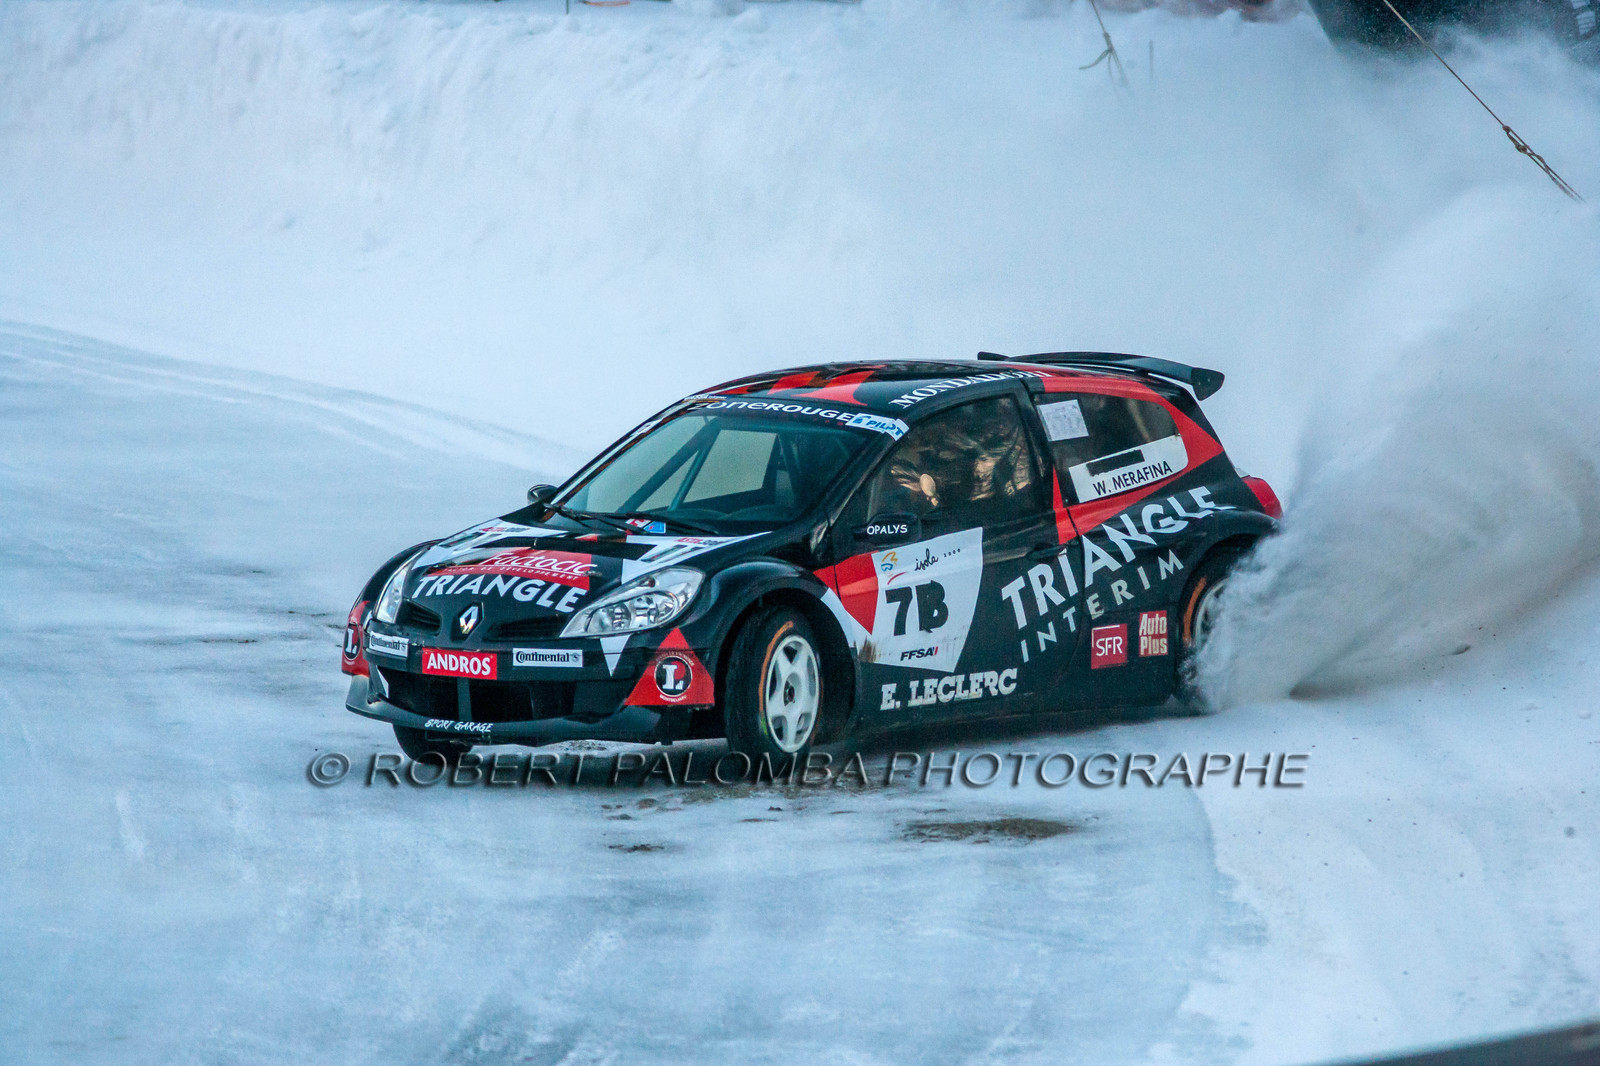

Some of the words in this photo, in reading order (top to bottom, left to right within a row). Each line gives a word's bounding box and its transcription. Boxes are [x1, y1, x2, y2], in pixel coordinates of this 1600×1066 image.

[1093, 480, 1111, 496] W.
[1113, 460, 1173, 491] MERAFINA
[867, 524, 908, 536] OPALYS
[1001, 486, 1236, 630] TRIANGLE
[411, 574, 588, 614] TRIANGLE
[1020, 549, 1184, 663] INTERIM
[885, 580, 949, 637] 7B
[1139, 613, 1168, 636] Auto
[515, 650, 570, 664] Continental
[900, 646, 935, 661] FFSA
[1096, 636, 1123, 656] SFR
[1140, 635, 1168, 656] Plus
[427, 652, 491, 676] ANDROS
[662, 664, 684, 690] L
[880, 683, 900, 711] E.
[907, 667, 1018, 707] LECLERC
[424, 718, 454, 730] SPORT
[454, 721, 494, 734] GARAGE
